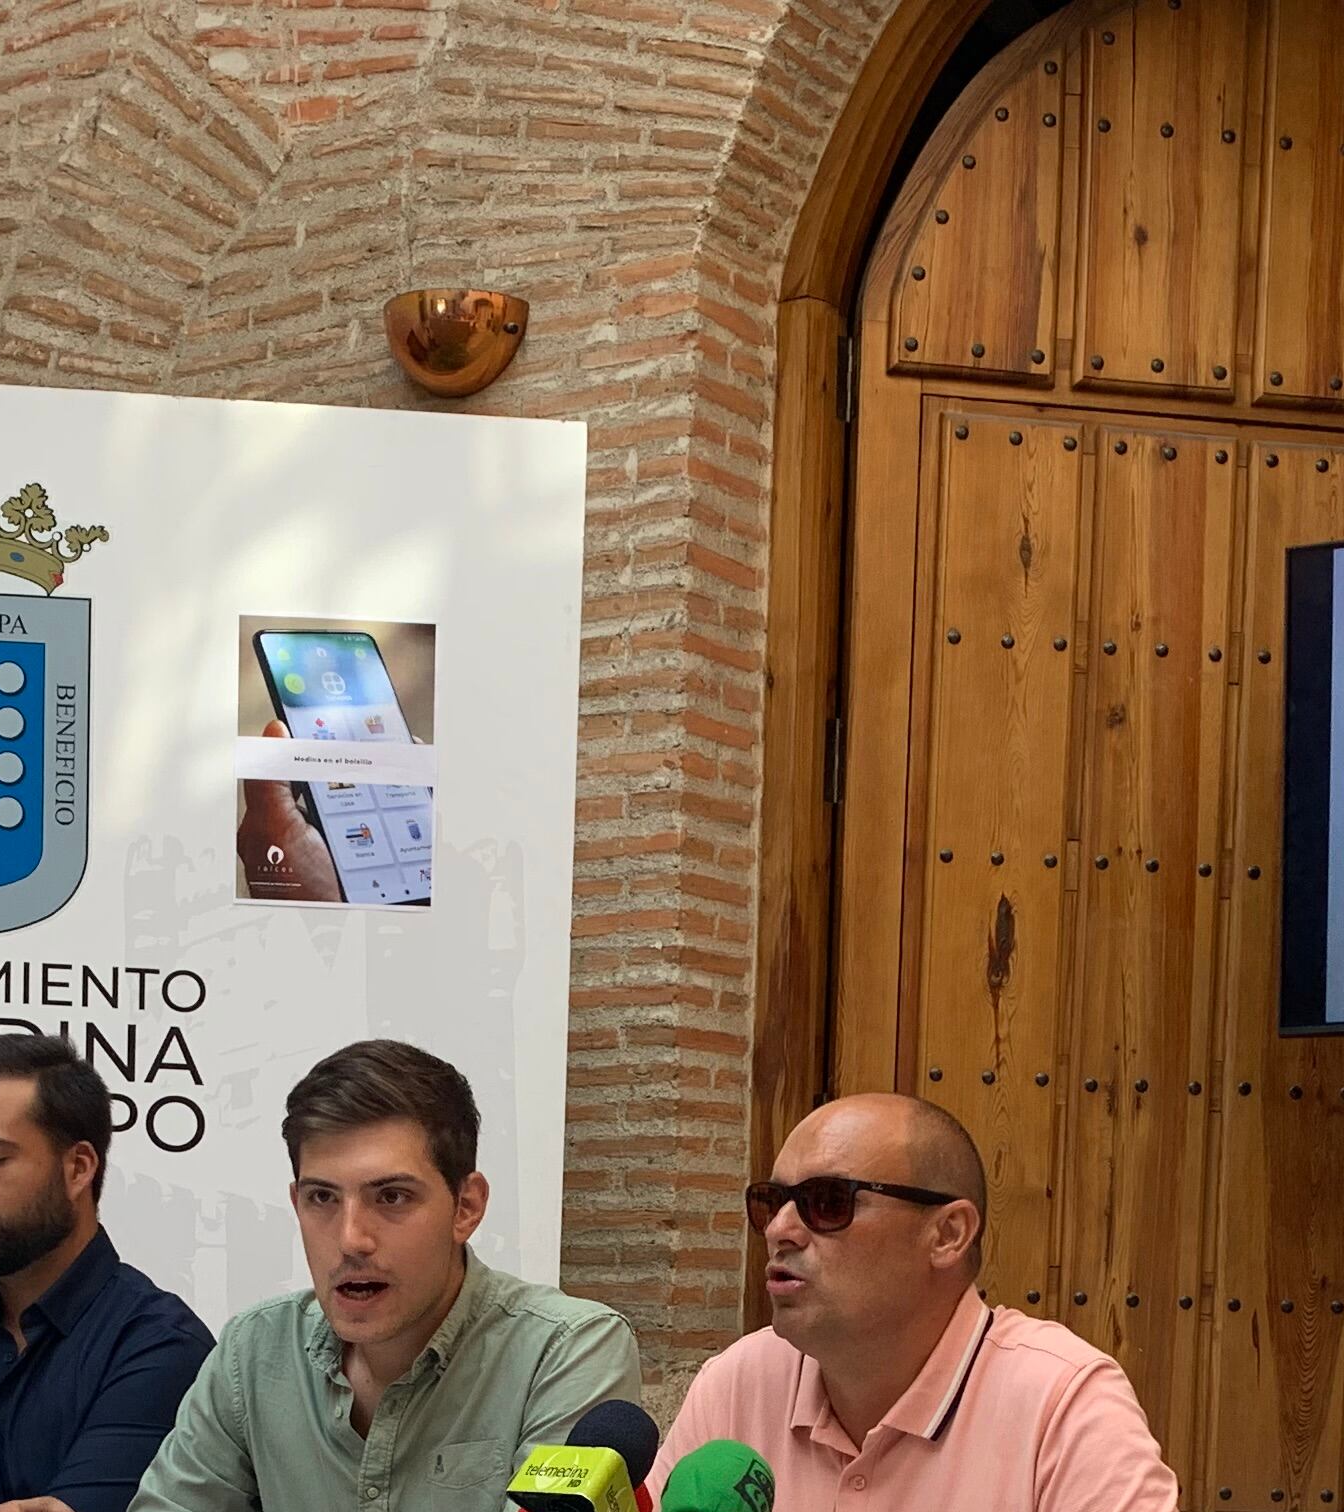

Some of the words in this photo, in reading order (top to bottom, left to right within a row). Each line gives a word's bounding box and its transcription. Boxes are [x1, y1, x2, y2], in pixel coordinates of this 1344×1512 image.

[54, 683, 77, 826] BENEFICIO
[525, 1462, 589, 1479] telemedina
[567, 1479, 581, 1488] HD
